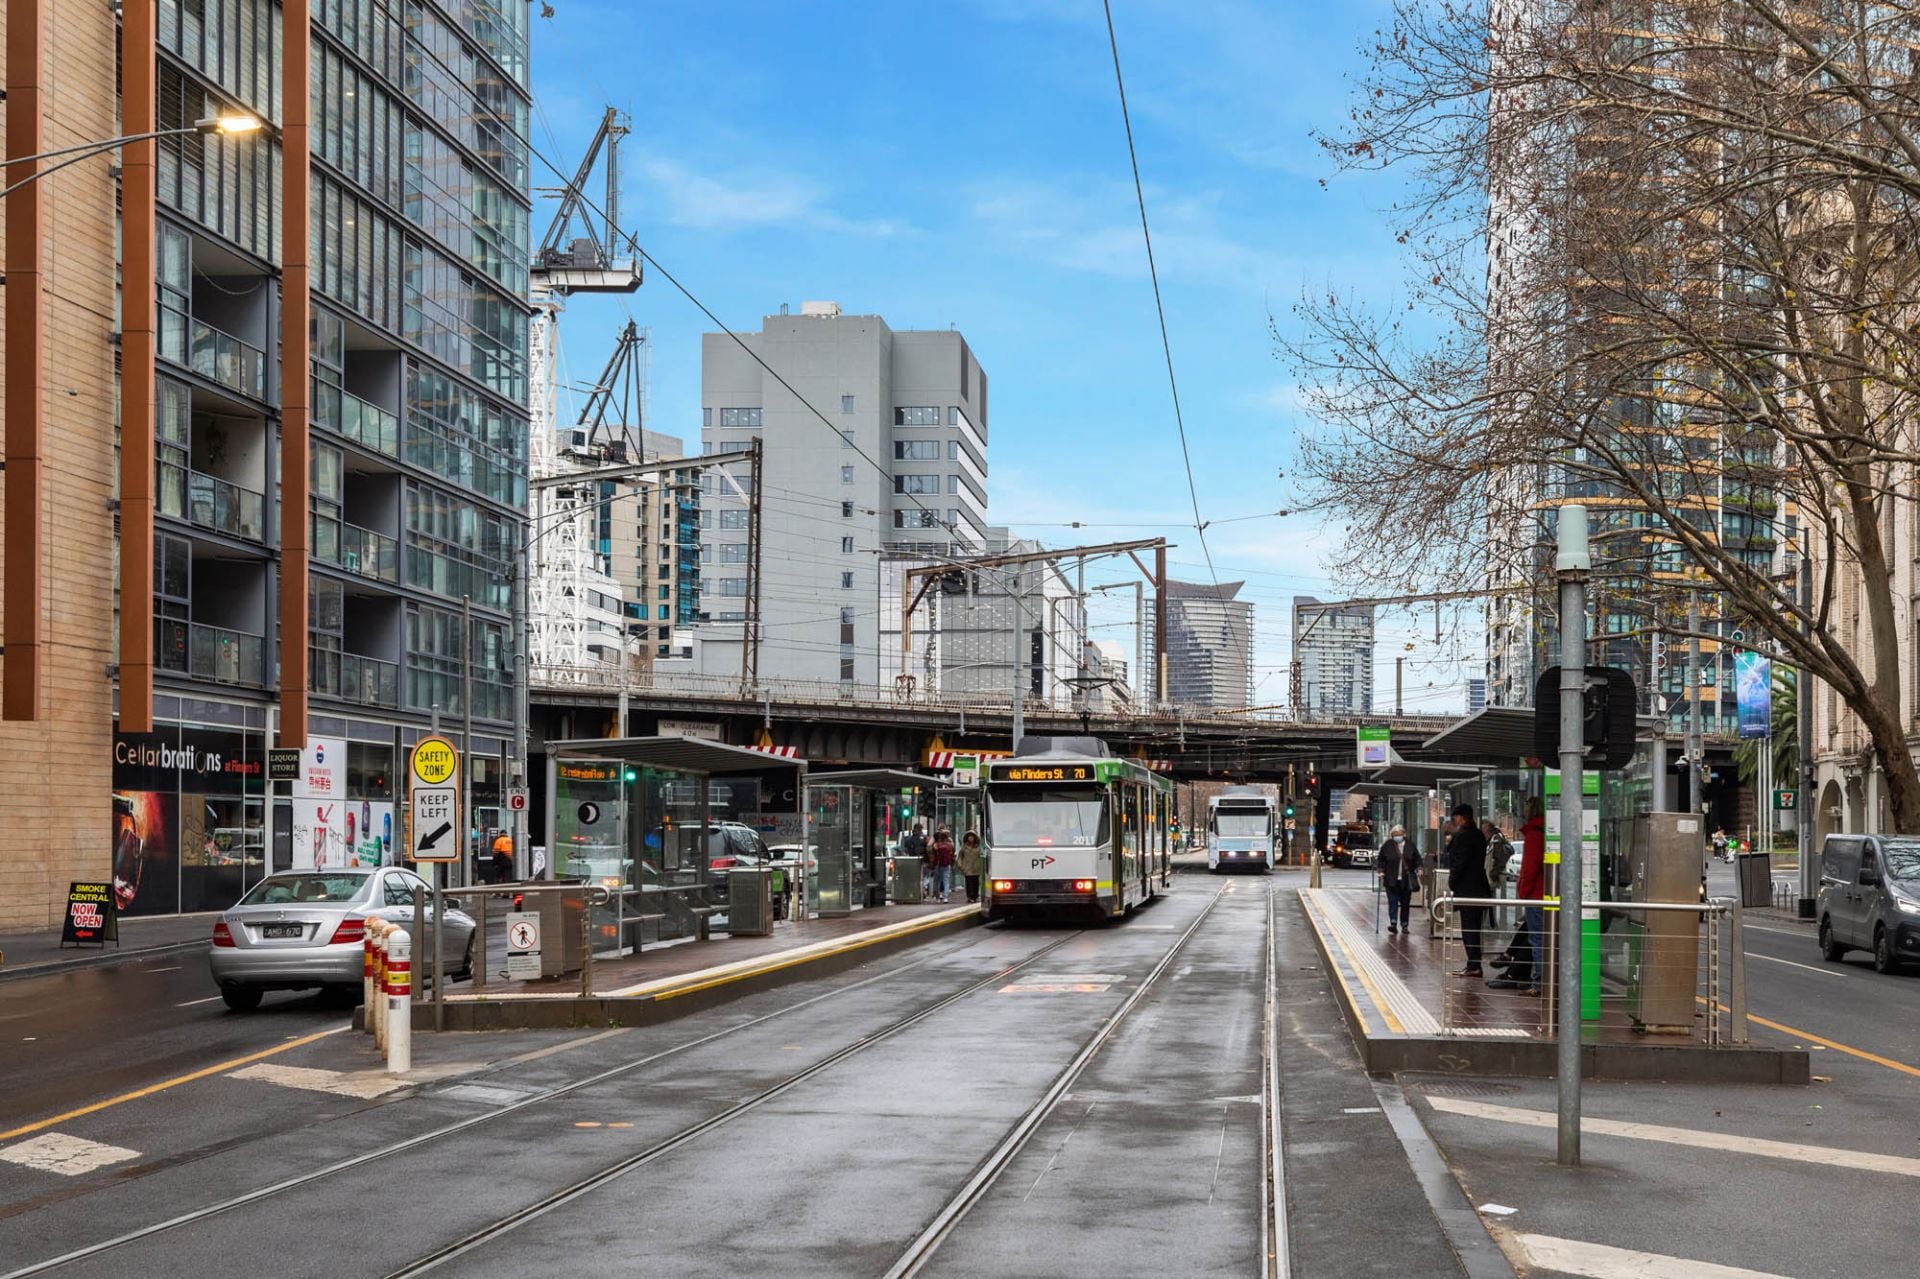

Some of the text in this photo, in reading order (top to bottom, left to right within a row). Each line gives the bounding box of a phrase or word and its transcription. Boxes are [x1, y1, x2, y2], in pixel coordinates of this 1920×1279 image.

[680, 722, 716, 732] CLEARANCE
[115, 742, 222, 774] Cellarbrations
[270, 754, 298, 763] LIQUOR
[419, 751, 450, 762] SAFETY
[272, 764, 296, 772] STORE
[424, 765, 446, 776] ZONE
[1009, 768, 1086, 779] via Flinders St 70
[420, 795, 449, 805] KEEP
[421, 808, 448, 818] LEFT
[76, 885, 106, 893] SMOKE
[70, 894, 109, 902] CENTRAL
[72, 903, 97, 915] NOW
[74, 915, 103, 927] OPEN
